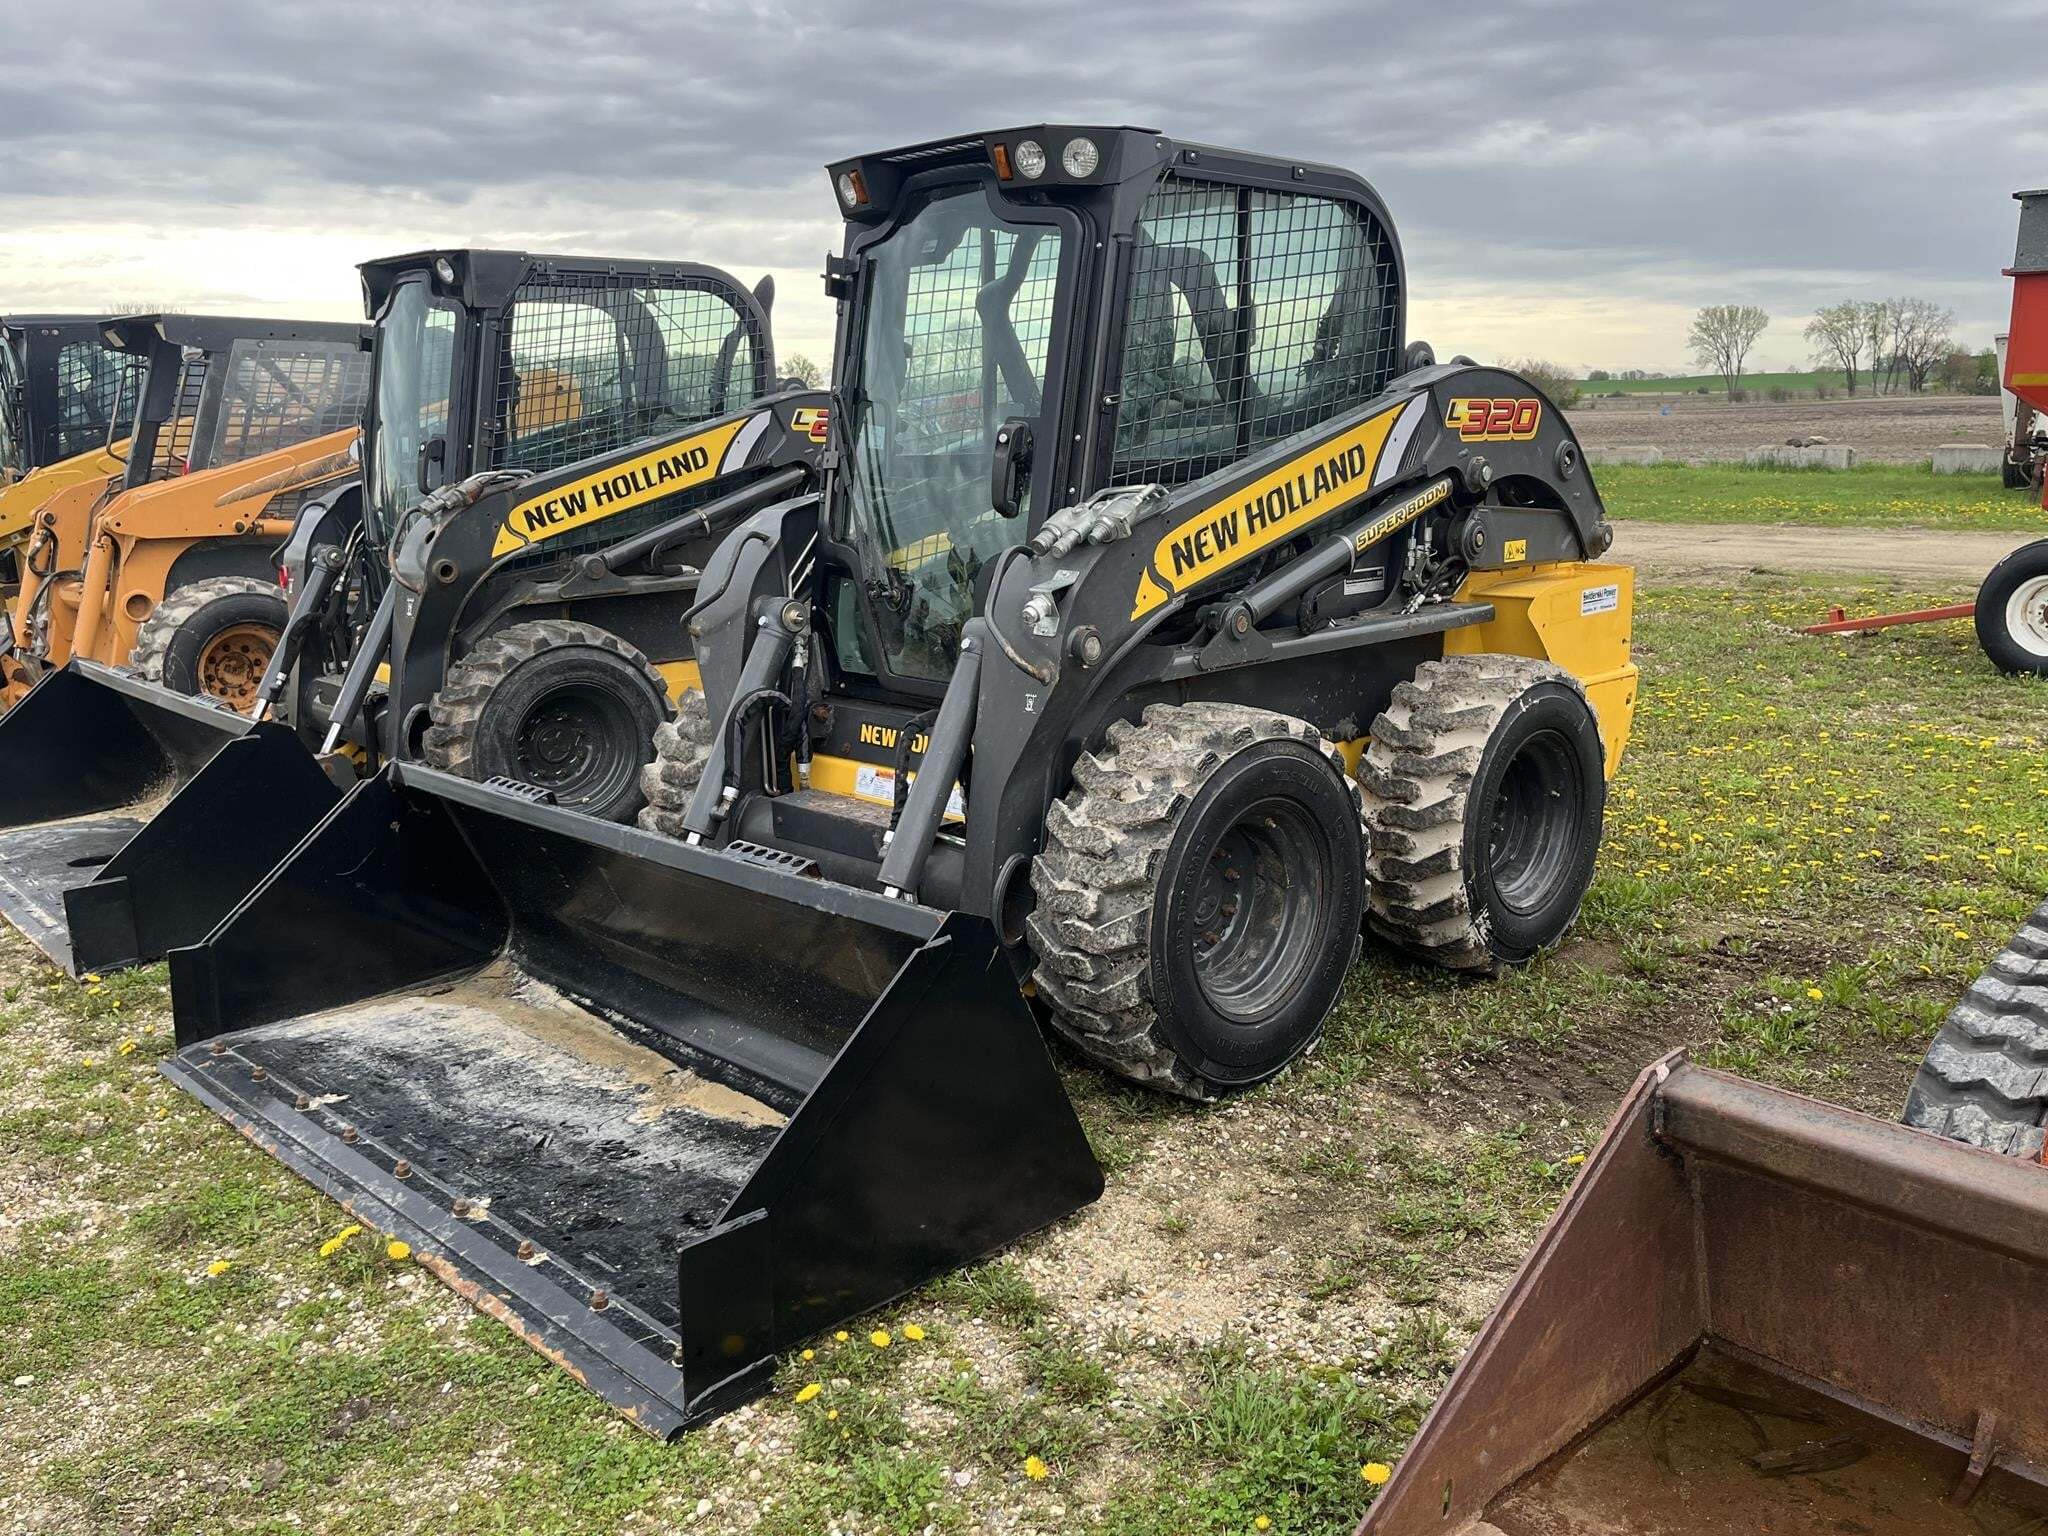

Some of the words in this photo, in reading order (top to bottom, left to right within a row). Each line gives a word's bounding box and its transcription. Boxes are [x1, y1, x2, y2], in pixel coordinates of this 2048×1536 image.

[1446, 399, 1540, 440] L320
[523, 489, 588, 532] NEW
[591, 446, 709, 507] HOLLAND
[1170, 516, 1238, 576] NEW
[1244, 443, 1366, 536] HOLLAND
[1356, 507, 1406, 551] SUPER
[1406, 481, 1448, 519] BOOM
[860, 723, 897, 748] NEW
